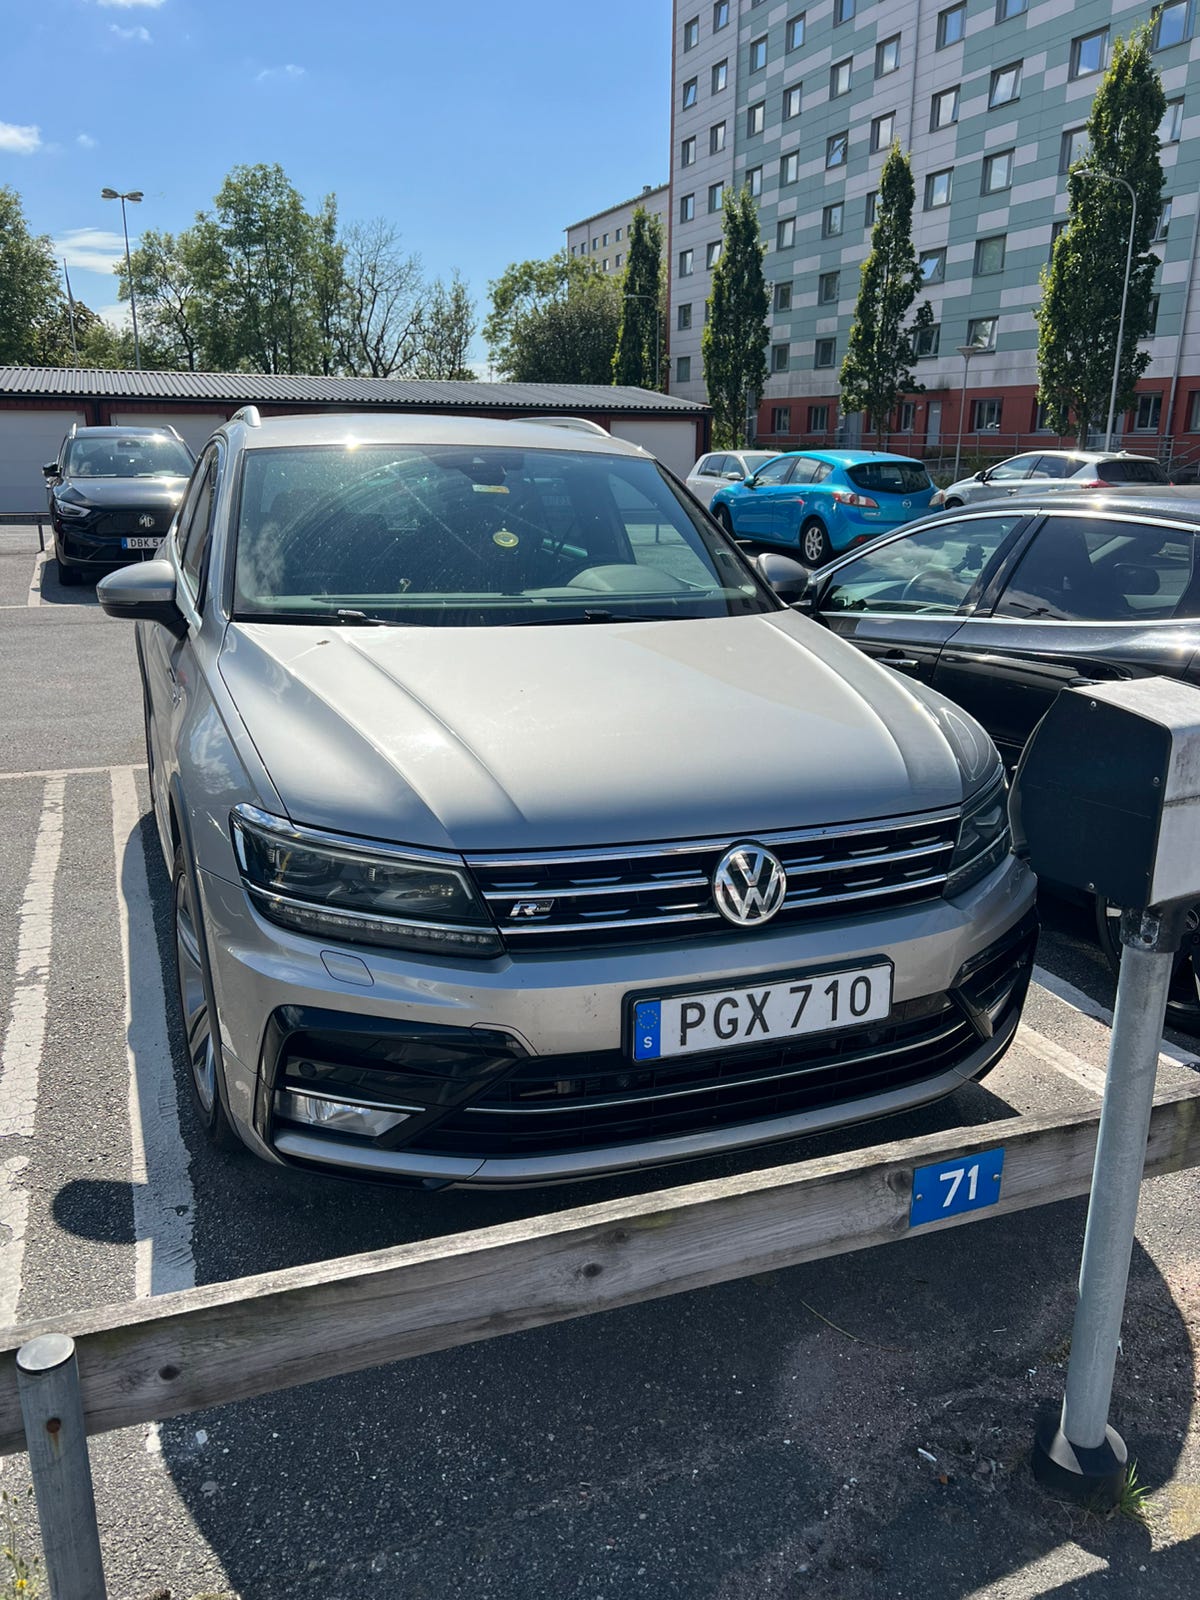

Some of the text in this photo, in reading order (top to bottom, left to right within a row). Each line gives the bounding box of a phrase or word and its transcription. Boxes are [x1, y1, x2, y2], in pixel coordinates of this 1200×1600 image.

[138, 514, 156, 528] MG
[130, 538, 150, 548] DBK
[718, 848, 783, 922] VW
[680, 975, 872, 1047] PGX 710
[643, 1036, 653, 1049] S
[939, 1164, 979, 1208] 71
